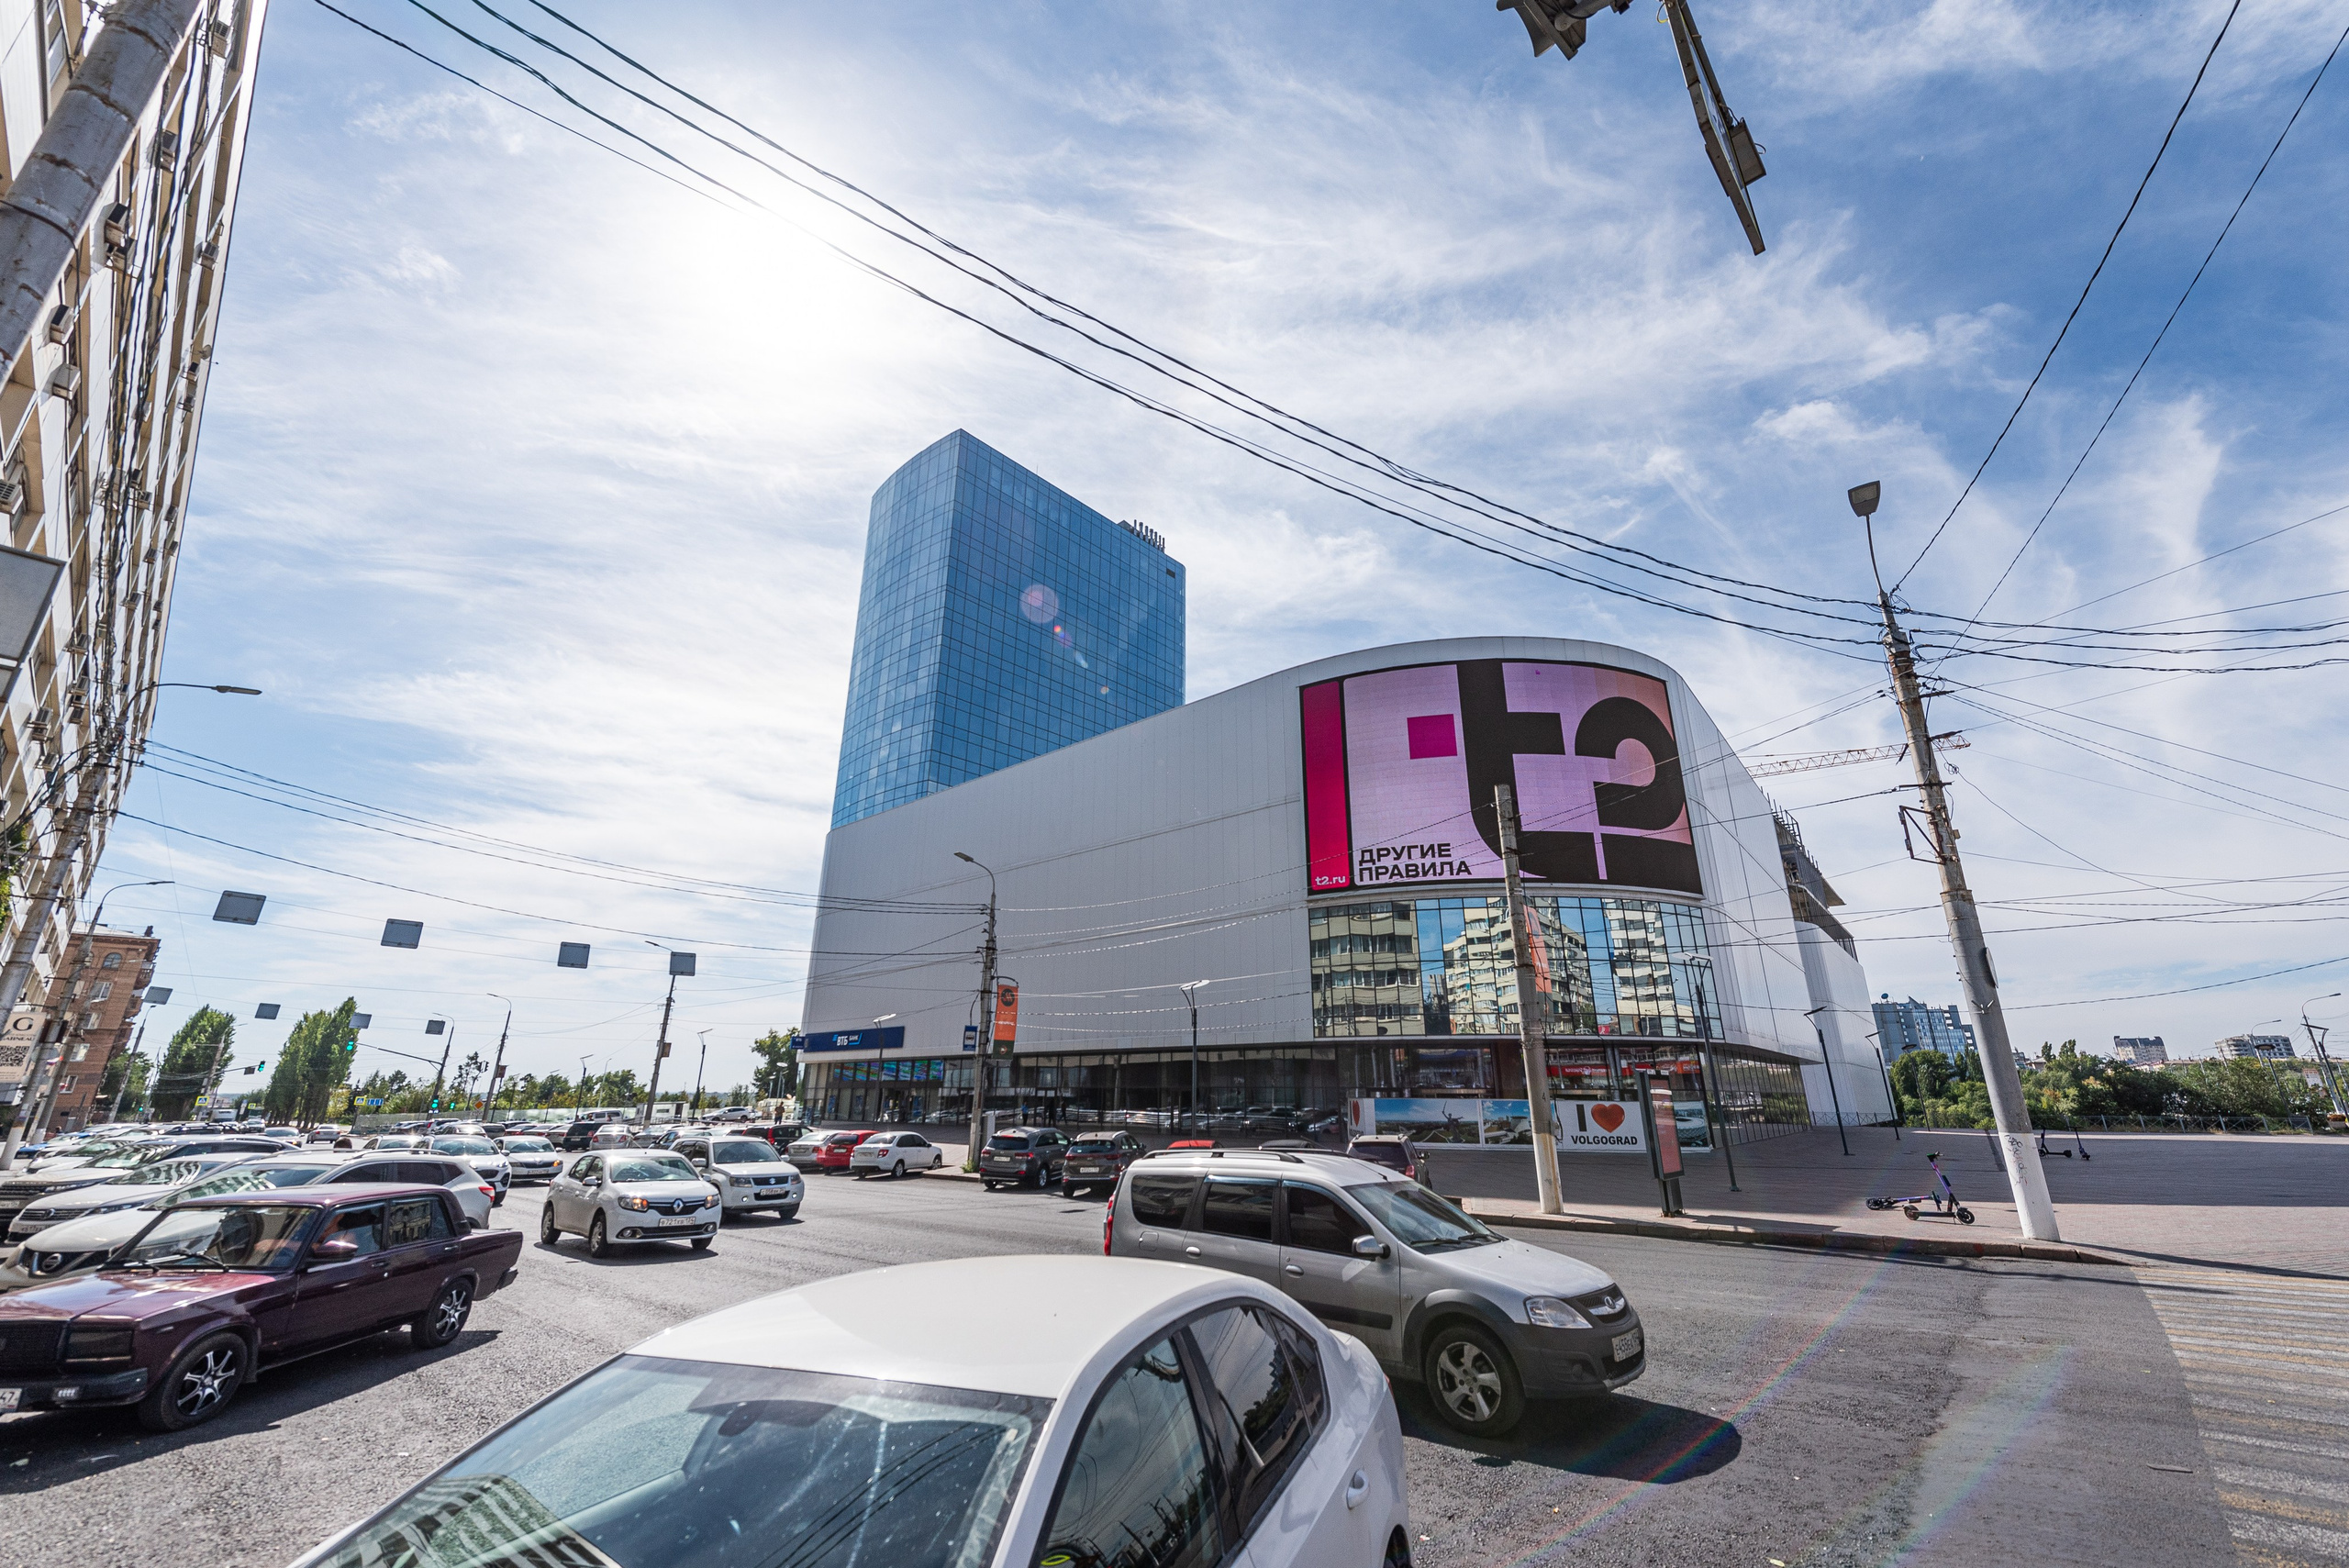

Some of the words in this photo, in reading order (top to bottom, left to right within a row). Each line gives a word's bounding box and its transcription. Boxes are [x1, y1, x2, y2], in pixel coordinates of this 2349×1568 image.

[1358, 843, 1452, 866] ДРУГИЕ
[1359, 861, 1473, 882] ПРАВИЛА
[1315, 875, 1346, 886] t2.ru
[837, 1037, 848, 1046] ВТБ
[1575, 1104, 1587, 1132] I
[1571, 1135, 1638, 1146] VOLGOGRAD
